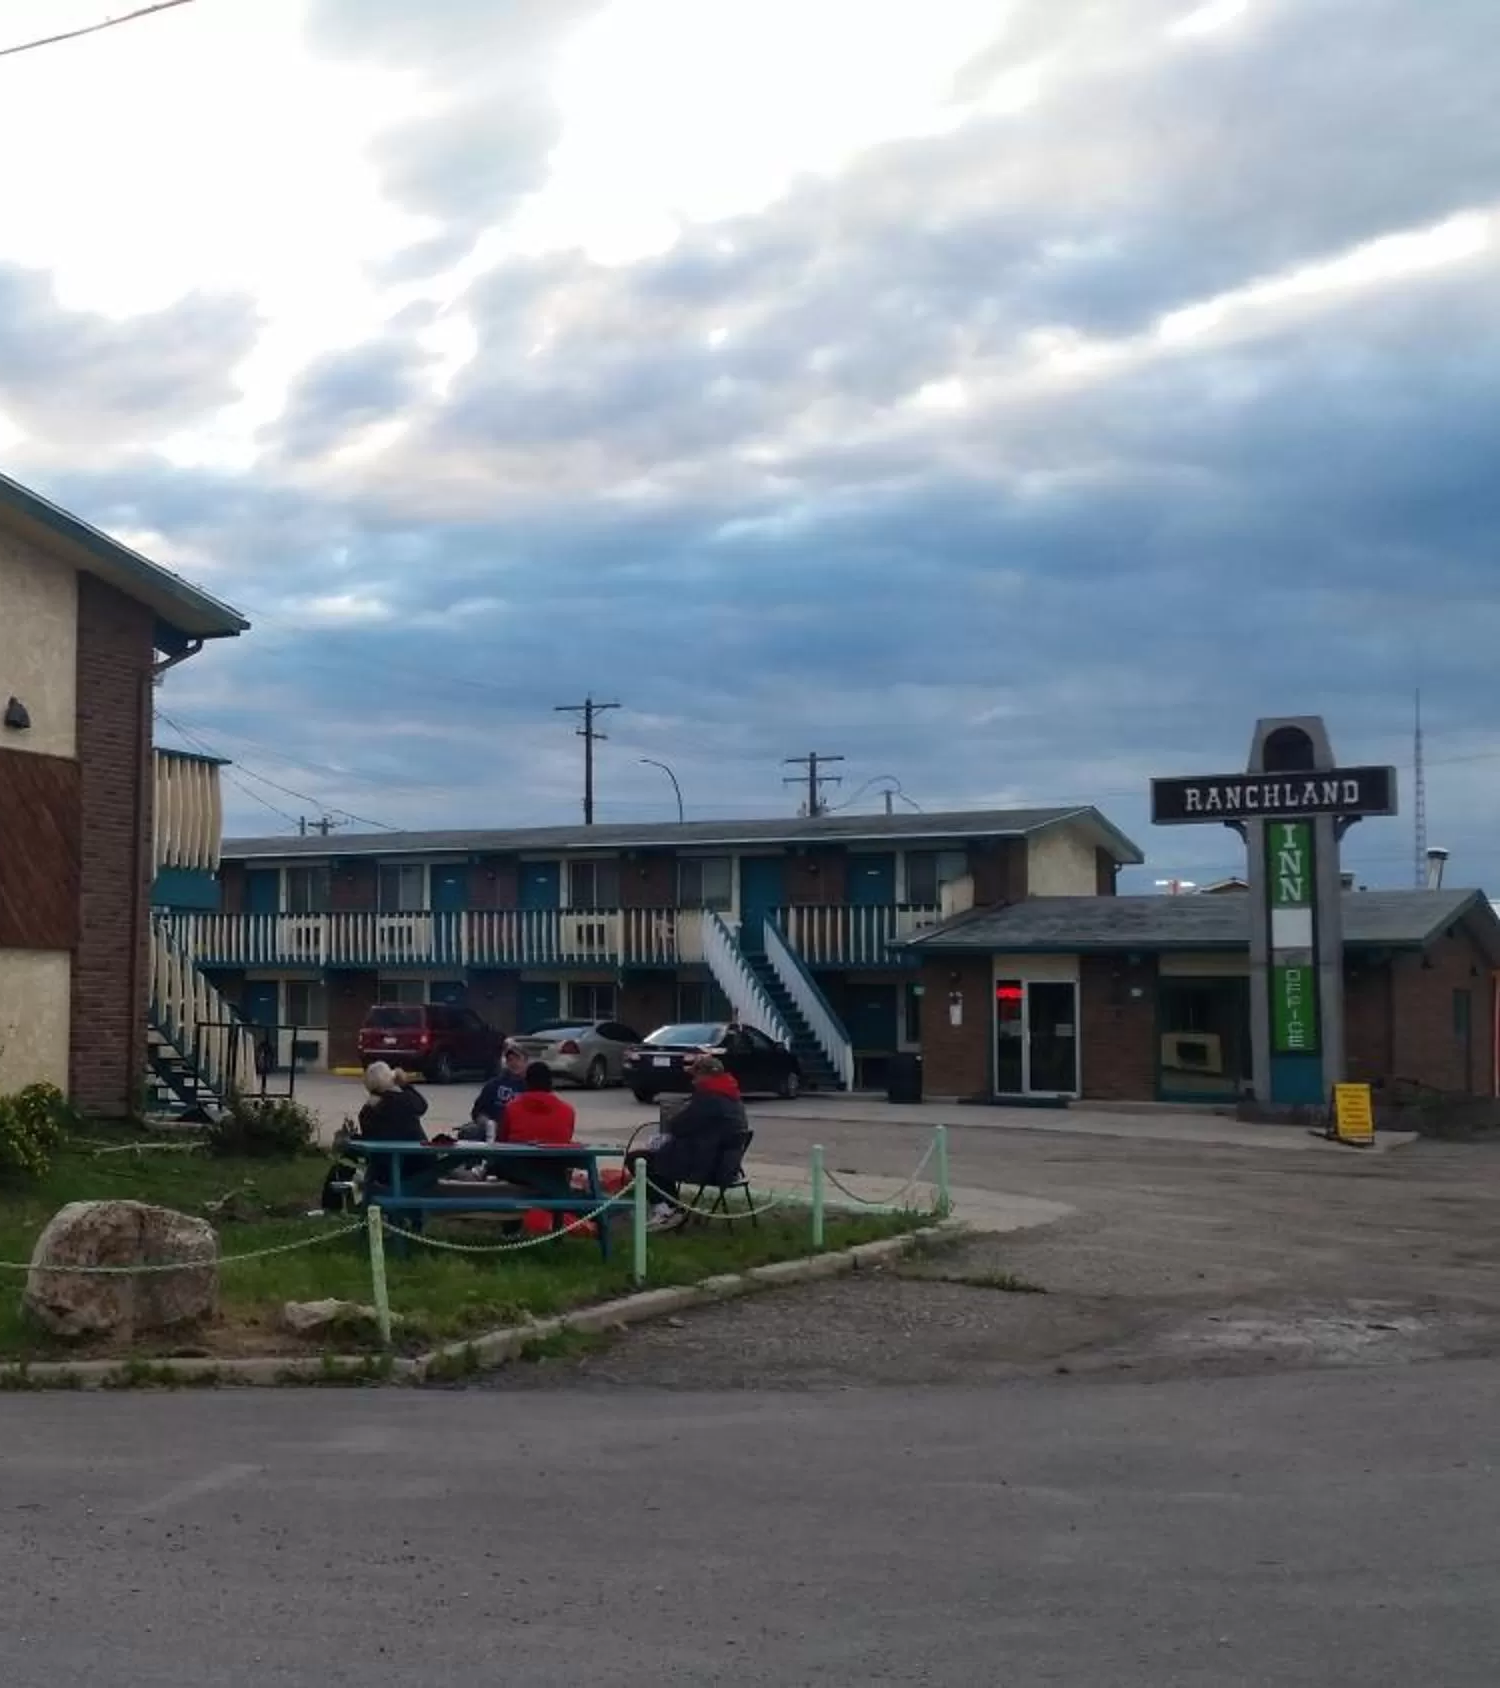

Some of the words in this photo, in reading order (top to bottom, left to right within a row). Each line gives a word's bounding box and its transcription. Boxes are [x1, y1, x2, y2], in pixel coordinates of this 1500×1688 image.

[1184, 780, 1360, 811] RANCHLAND
[1278, 824, 1303, 901] INN
[1286, 969, 1304, 1047] OFFICE
